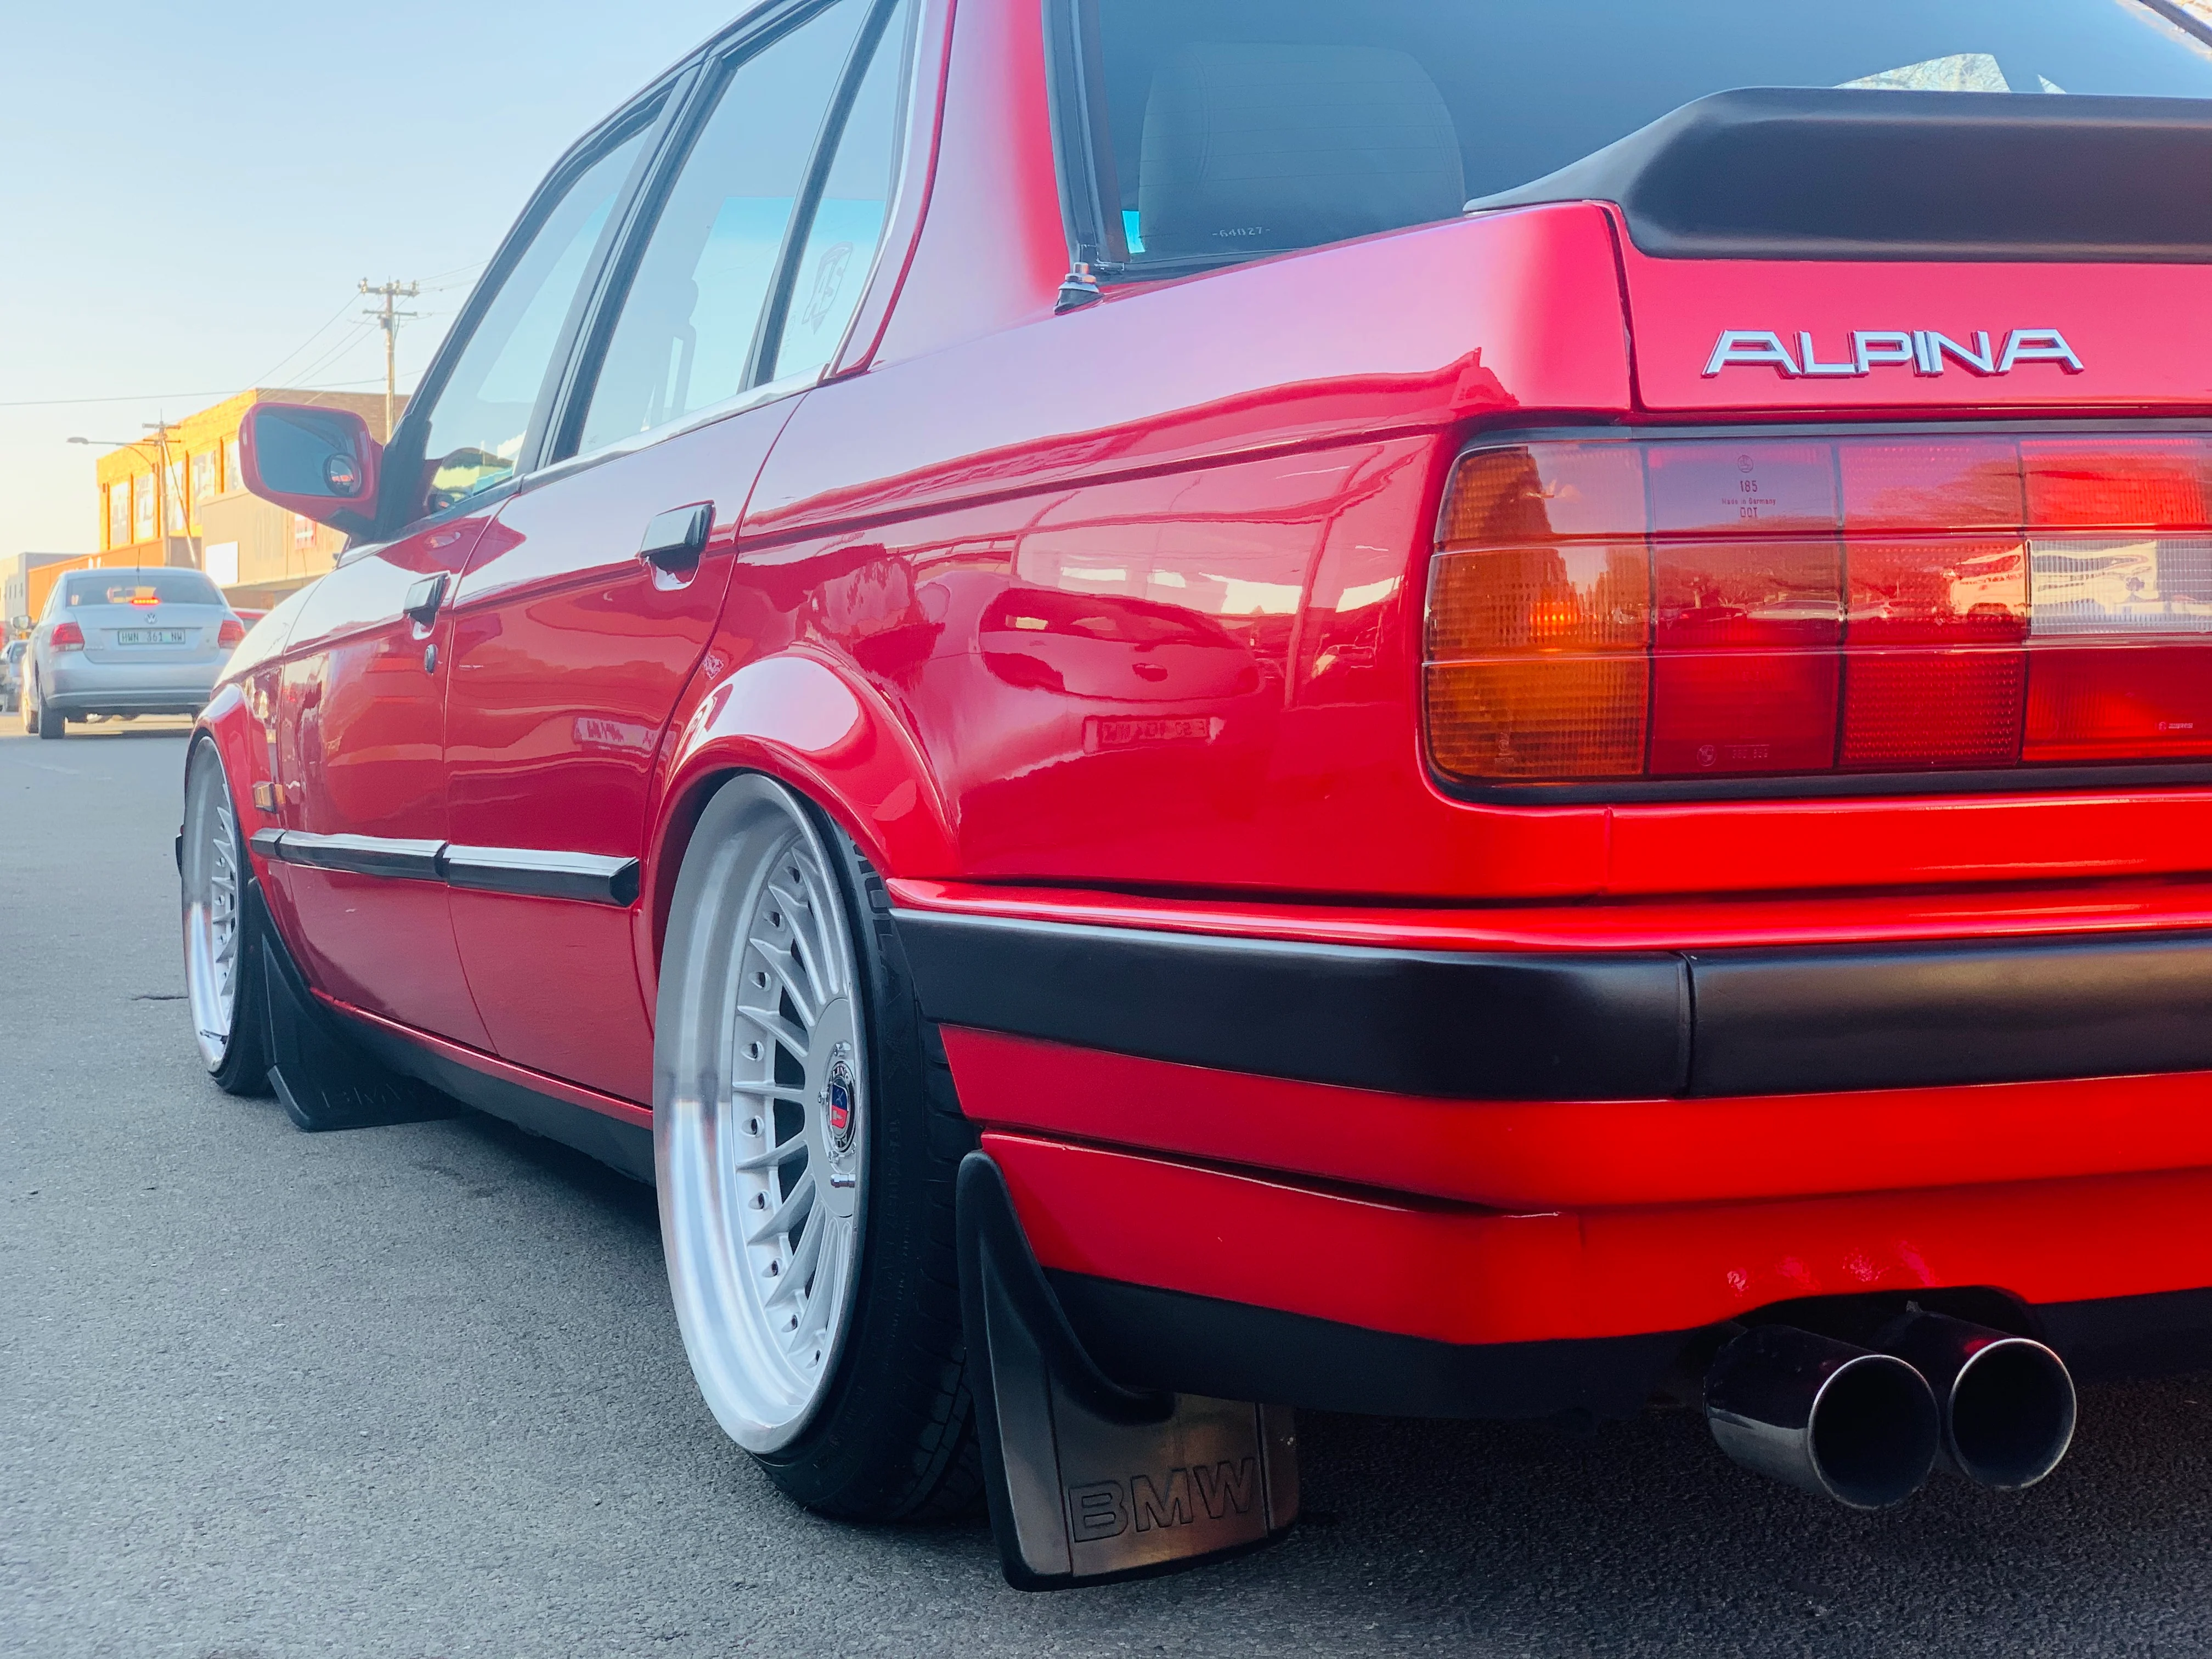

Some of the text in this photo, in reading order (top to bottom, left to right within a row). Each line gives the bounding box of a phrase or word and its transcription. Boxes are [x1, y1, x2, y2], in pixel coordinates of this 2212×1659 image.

[1701, 328, 2084, 379] ALPINA
[1740, 480, 1758, 492] 185
[1722, 497, 1739, 505] Made
[1748, 497, 1776, 506] Germany
[1740, 507, 1758, 518] DOT
[171, 631, 183, 641] NW
[1067, 1457, 1255, 1543] BMW
